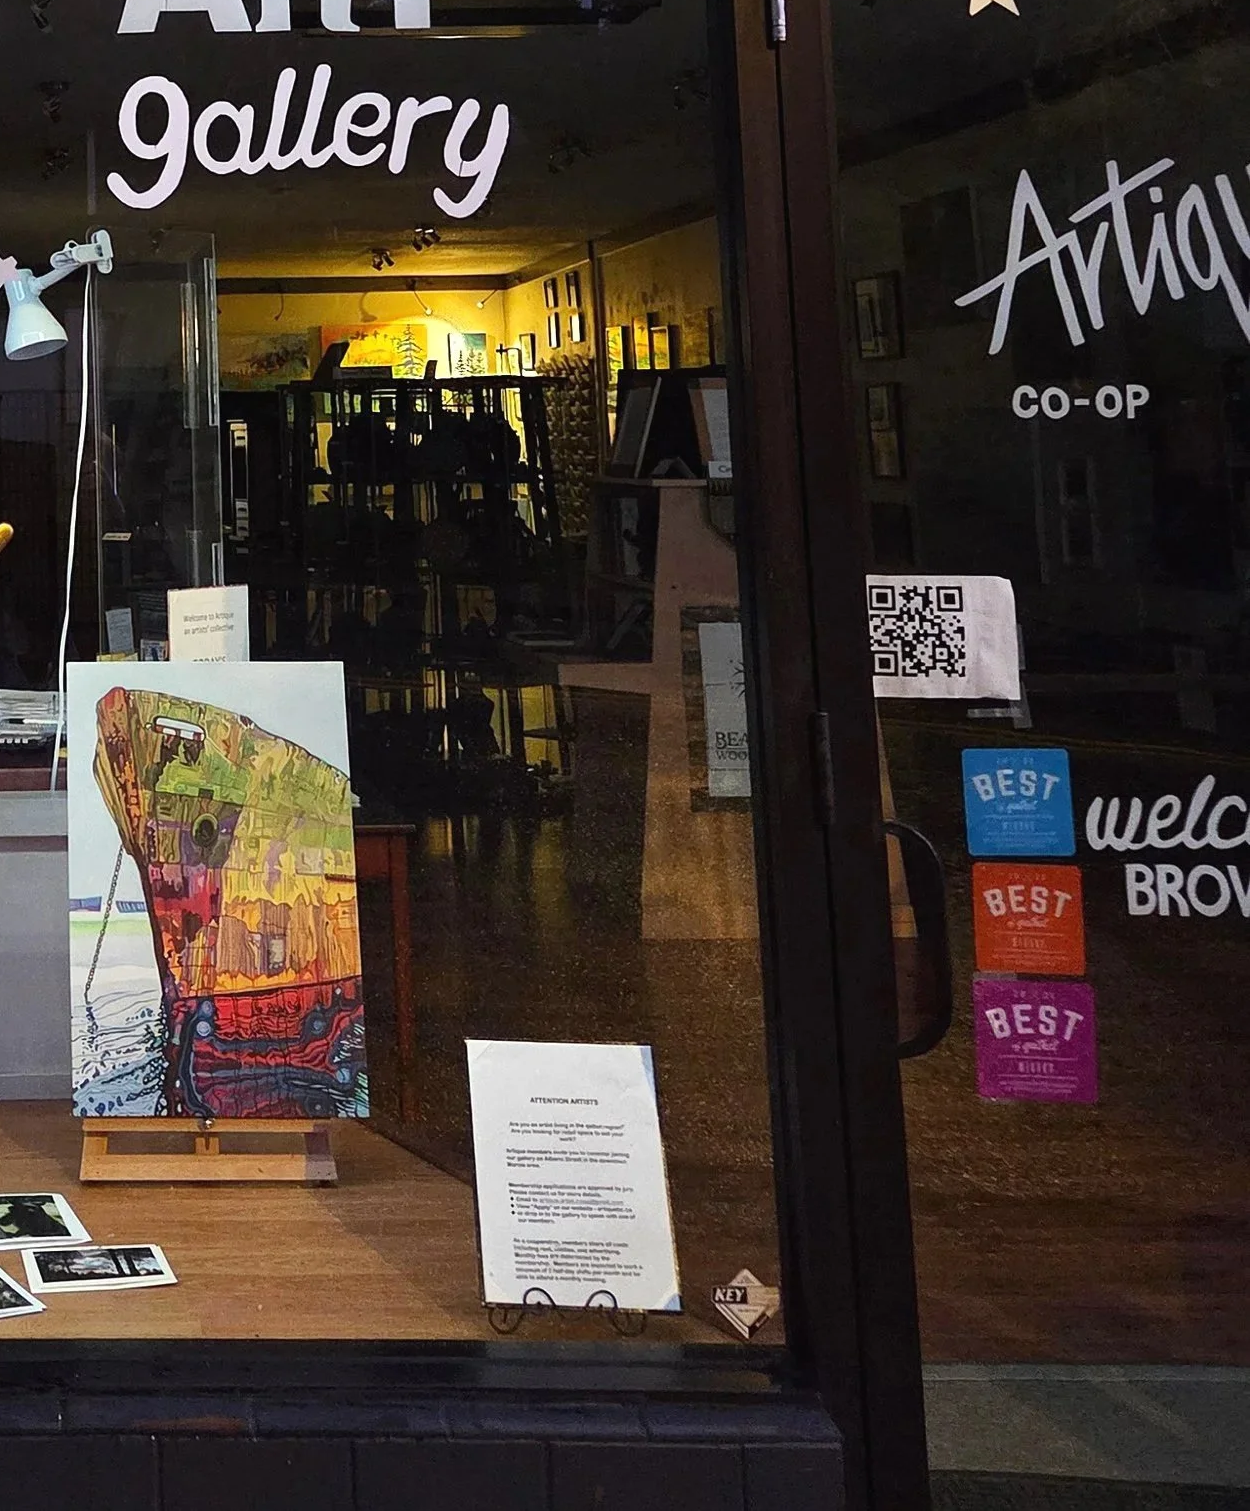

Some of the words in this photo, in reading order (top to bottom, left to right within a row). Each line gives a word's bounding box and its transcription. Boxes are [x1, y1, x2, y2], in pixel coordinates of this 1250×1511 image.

[107, 64, 510, 219] gallery
[1012, 384, 1150, 420] CO-OP
[972, 769, 1061, 802] BEST
[1085, 774, 1250, 852] welc
[983, 884, 1072, 919] BEST
[985, 1003, 1085, 1042] BEST
